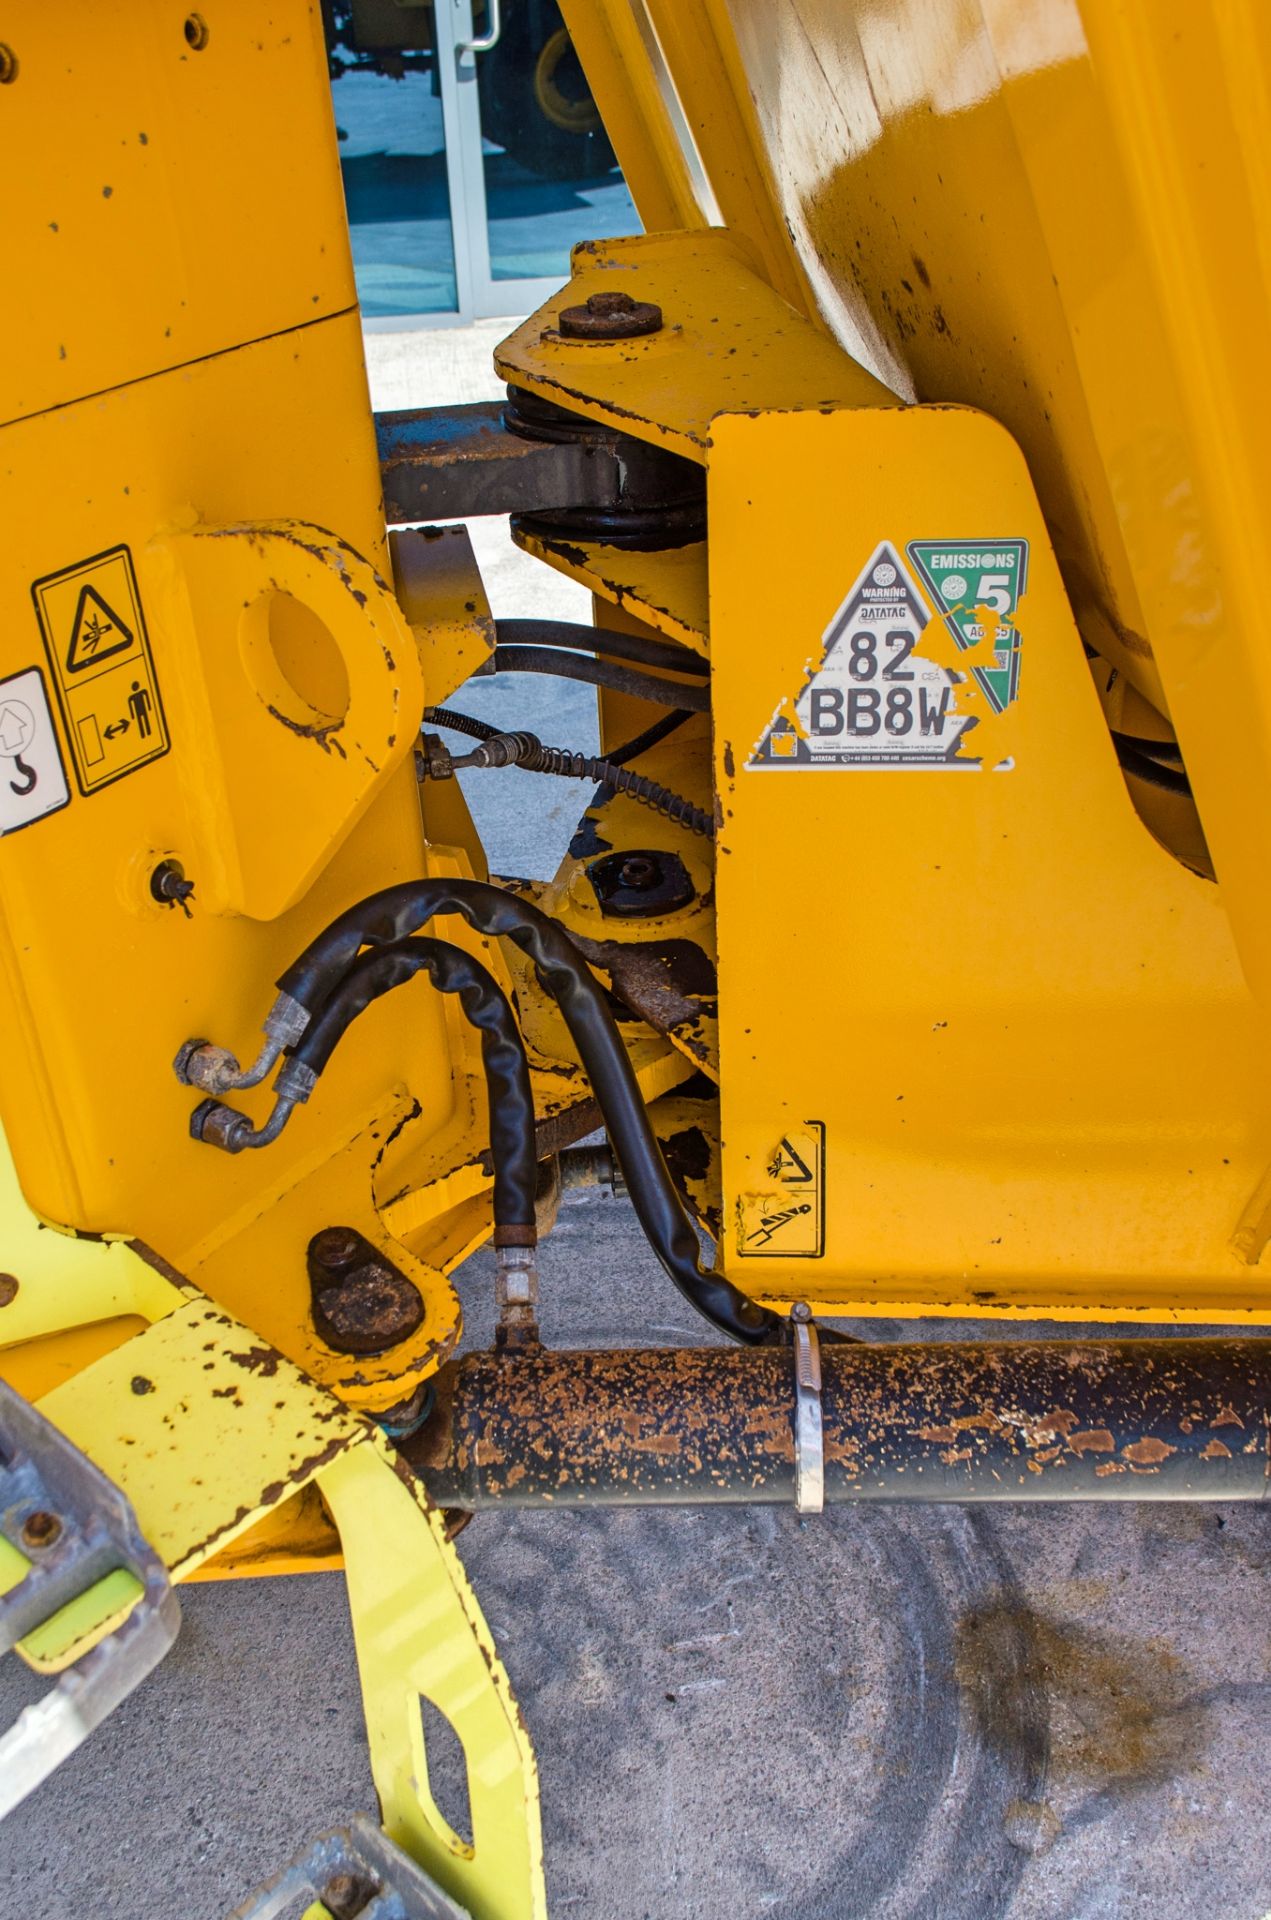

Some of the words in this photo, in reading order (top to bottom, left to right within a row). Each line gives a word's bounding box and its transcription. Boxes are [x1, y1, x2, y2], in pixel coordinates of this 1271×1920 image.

[931, 553, 1015, 569] EMISSIONS
[861, 587, 906, 598] WARNING
[974, 574, 1011, 616] 5
[861, 607, 906, 618] DATATAG
[848, 630, 915, 682] 82
[810, 687, 950, 737] BB8W
